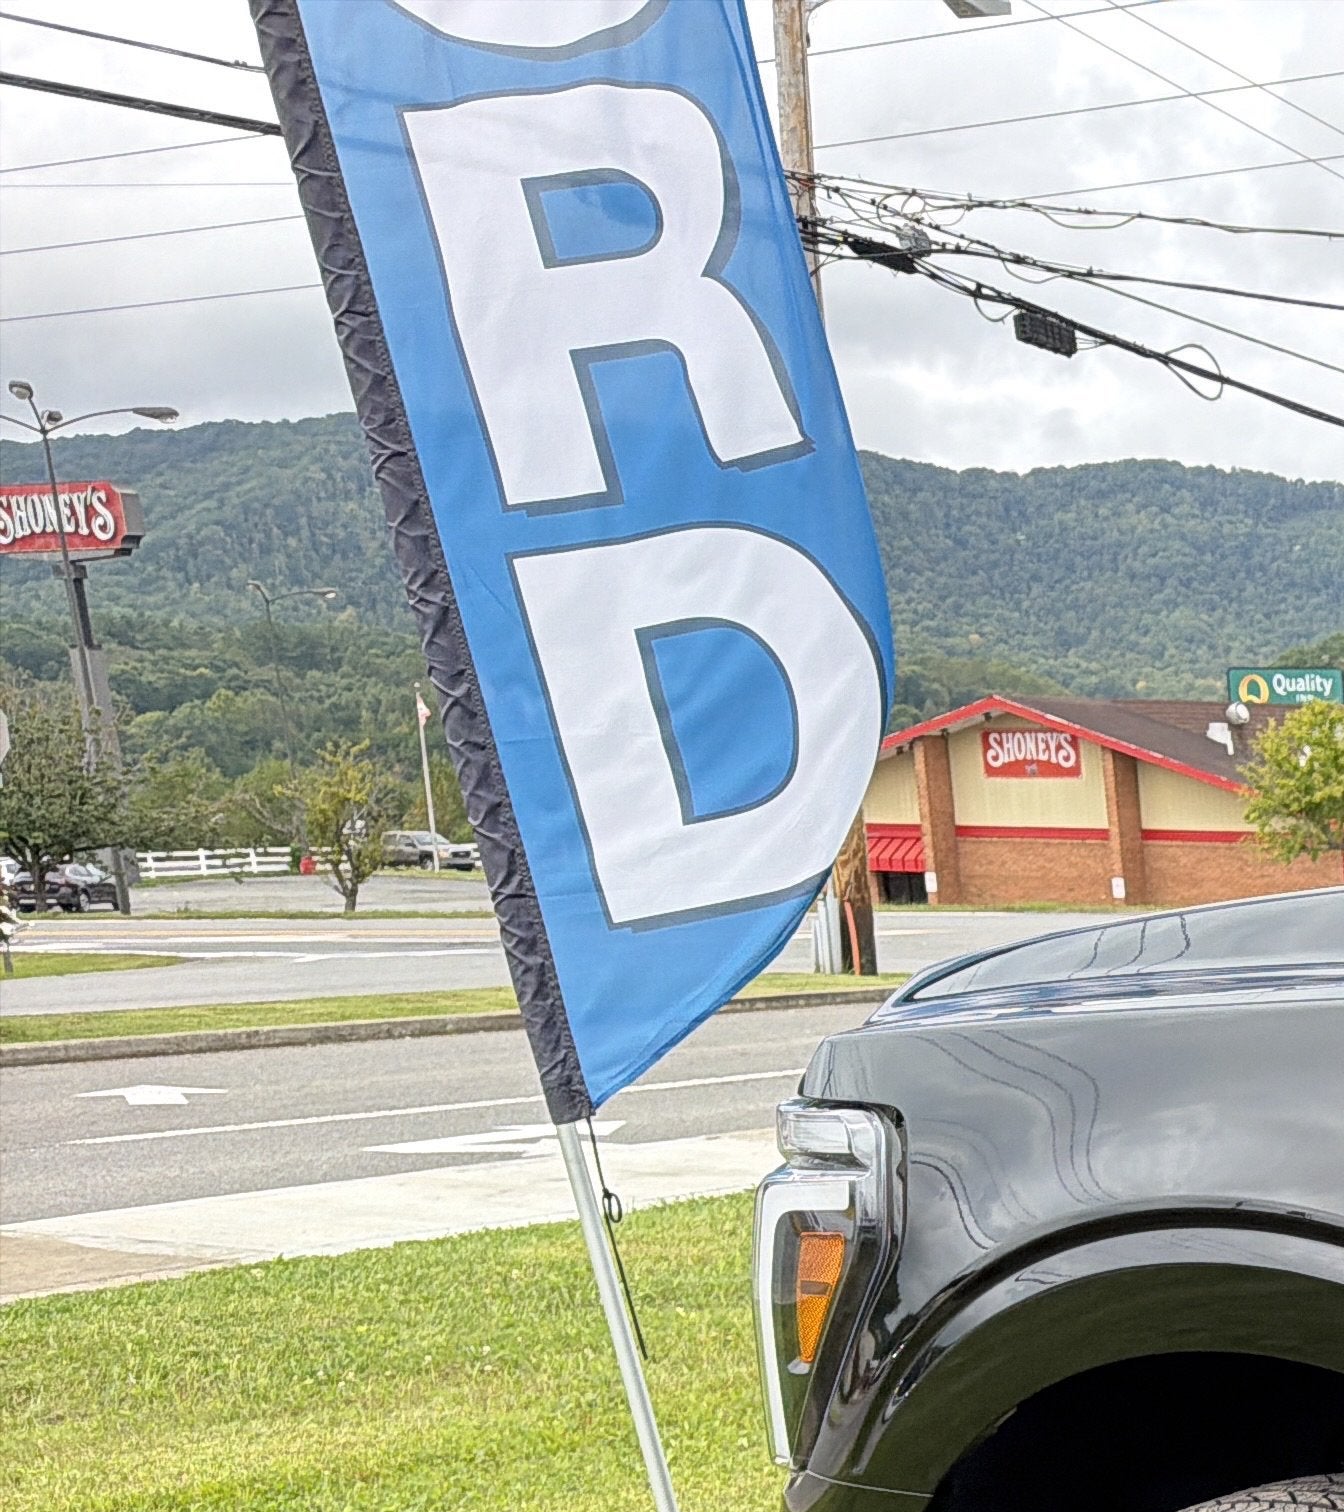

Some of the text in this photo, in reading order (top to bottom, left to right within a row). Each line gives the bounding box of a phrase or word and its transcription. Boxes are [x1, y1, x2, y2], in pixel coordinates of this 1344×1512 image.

[390, 0, 884, 930] RD
[1272, 673, 1333, 697] Quality
[986, 732, 1076, 768] SHONEY'S
